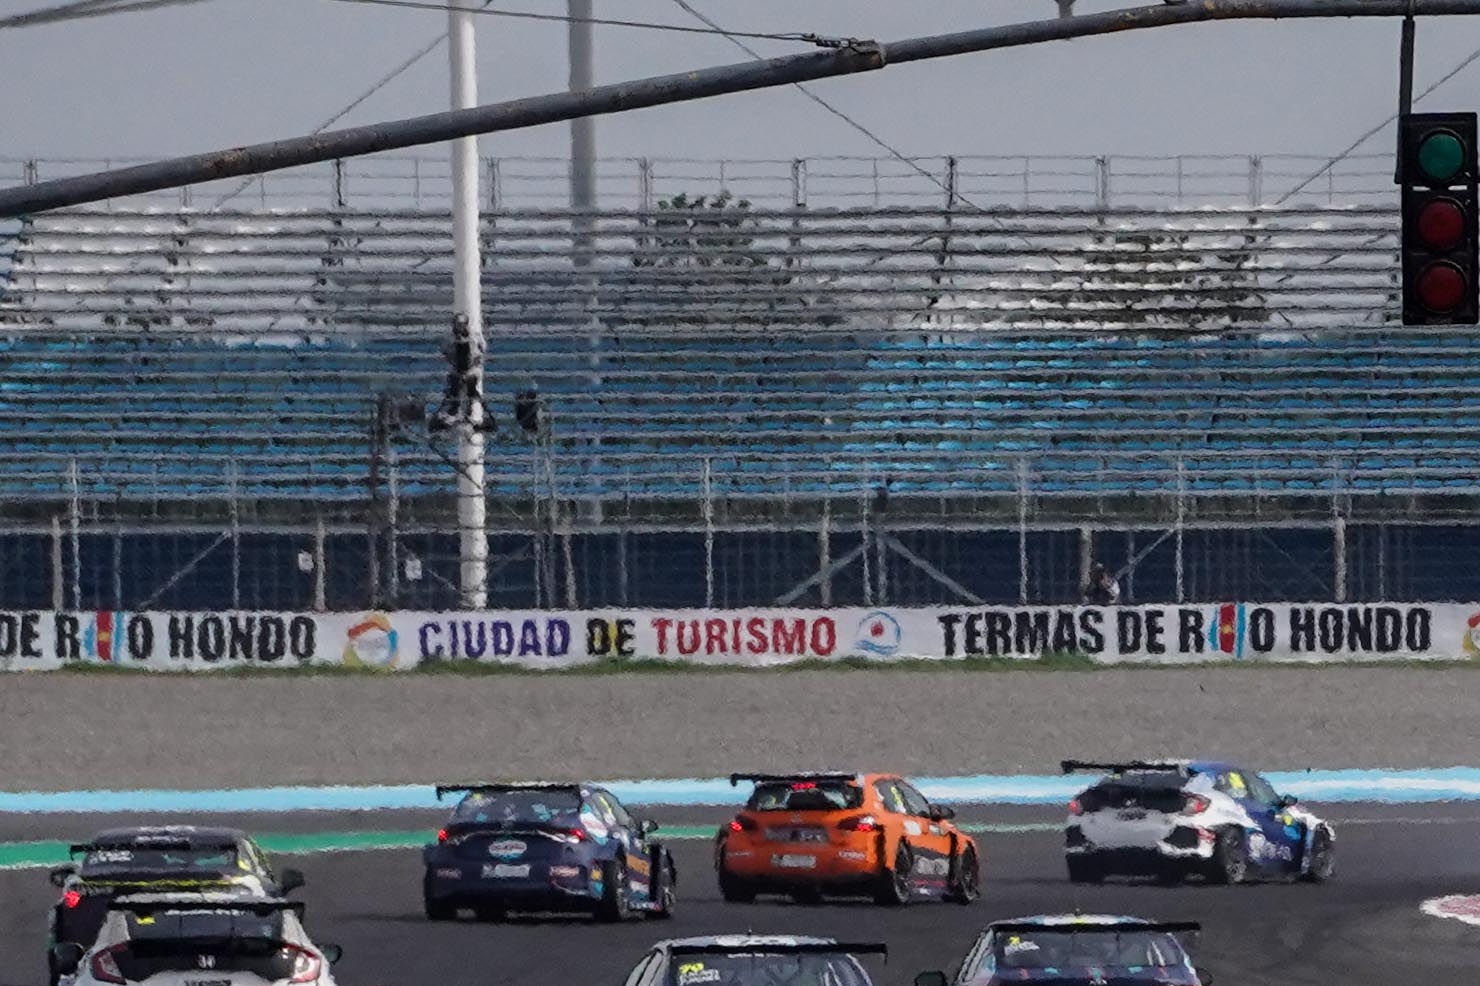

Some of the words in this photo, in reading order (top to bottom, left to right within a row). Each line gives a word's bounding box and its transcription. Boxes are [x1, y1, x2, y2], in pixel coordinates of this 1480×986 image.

[168, 614, 317, 660] HONDO
[418, 618, 572, 657] CIUDAD
[586, 617, 636, 656] DE
[651, 616, 838, 656] TURISMO
[938, 610, 1105, 656] TERMAS
[1118, 609, 1166, 653] DE
[1290, 608, 1432, 653] HONDO
